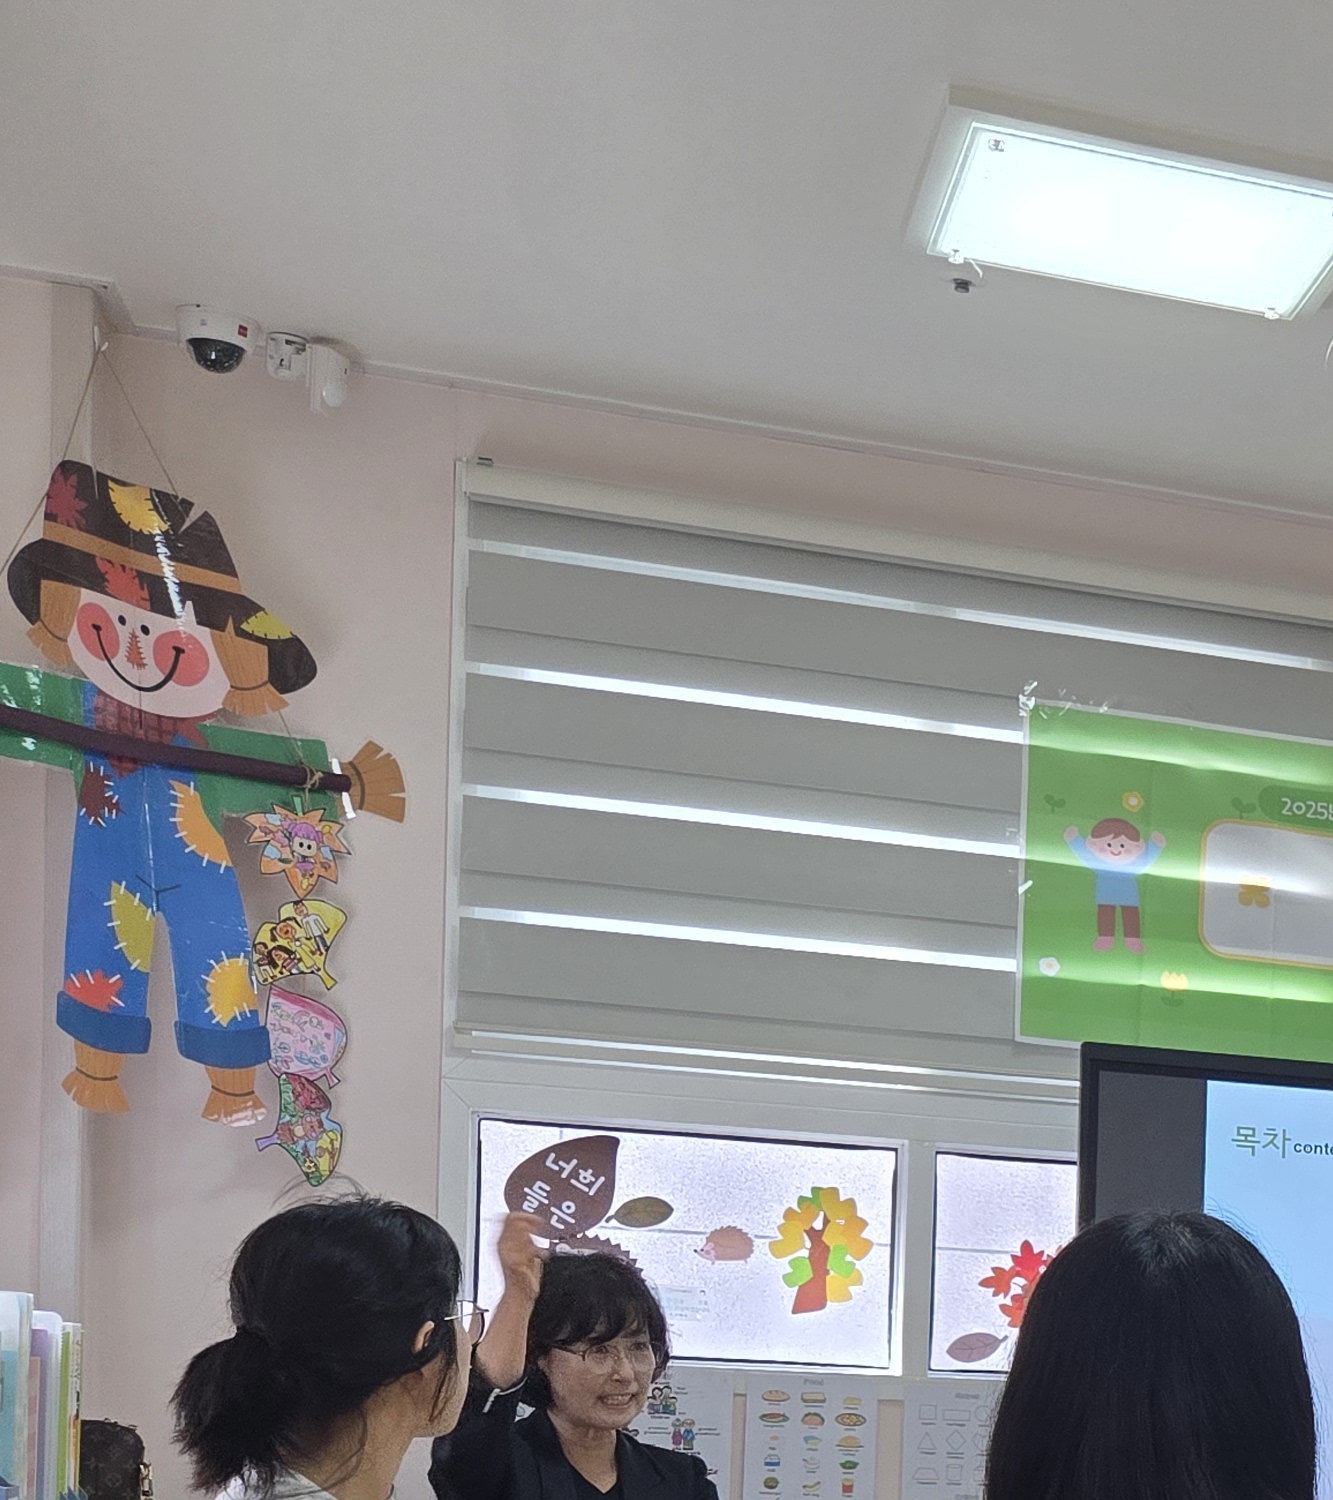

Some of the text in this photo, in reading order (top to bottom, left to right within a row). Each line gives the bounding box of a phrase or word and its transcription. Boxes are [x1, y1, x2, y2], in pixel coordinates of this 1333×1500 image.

[1231, 1126, 1292, 1159] 목차
[545, 1152, 605, 1196] 너희
[522, 1180, 577, 1230] 들은
